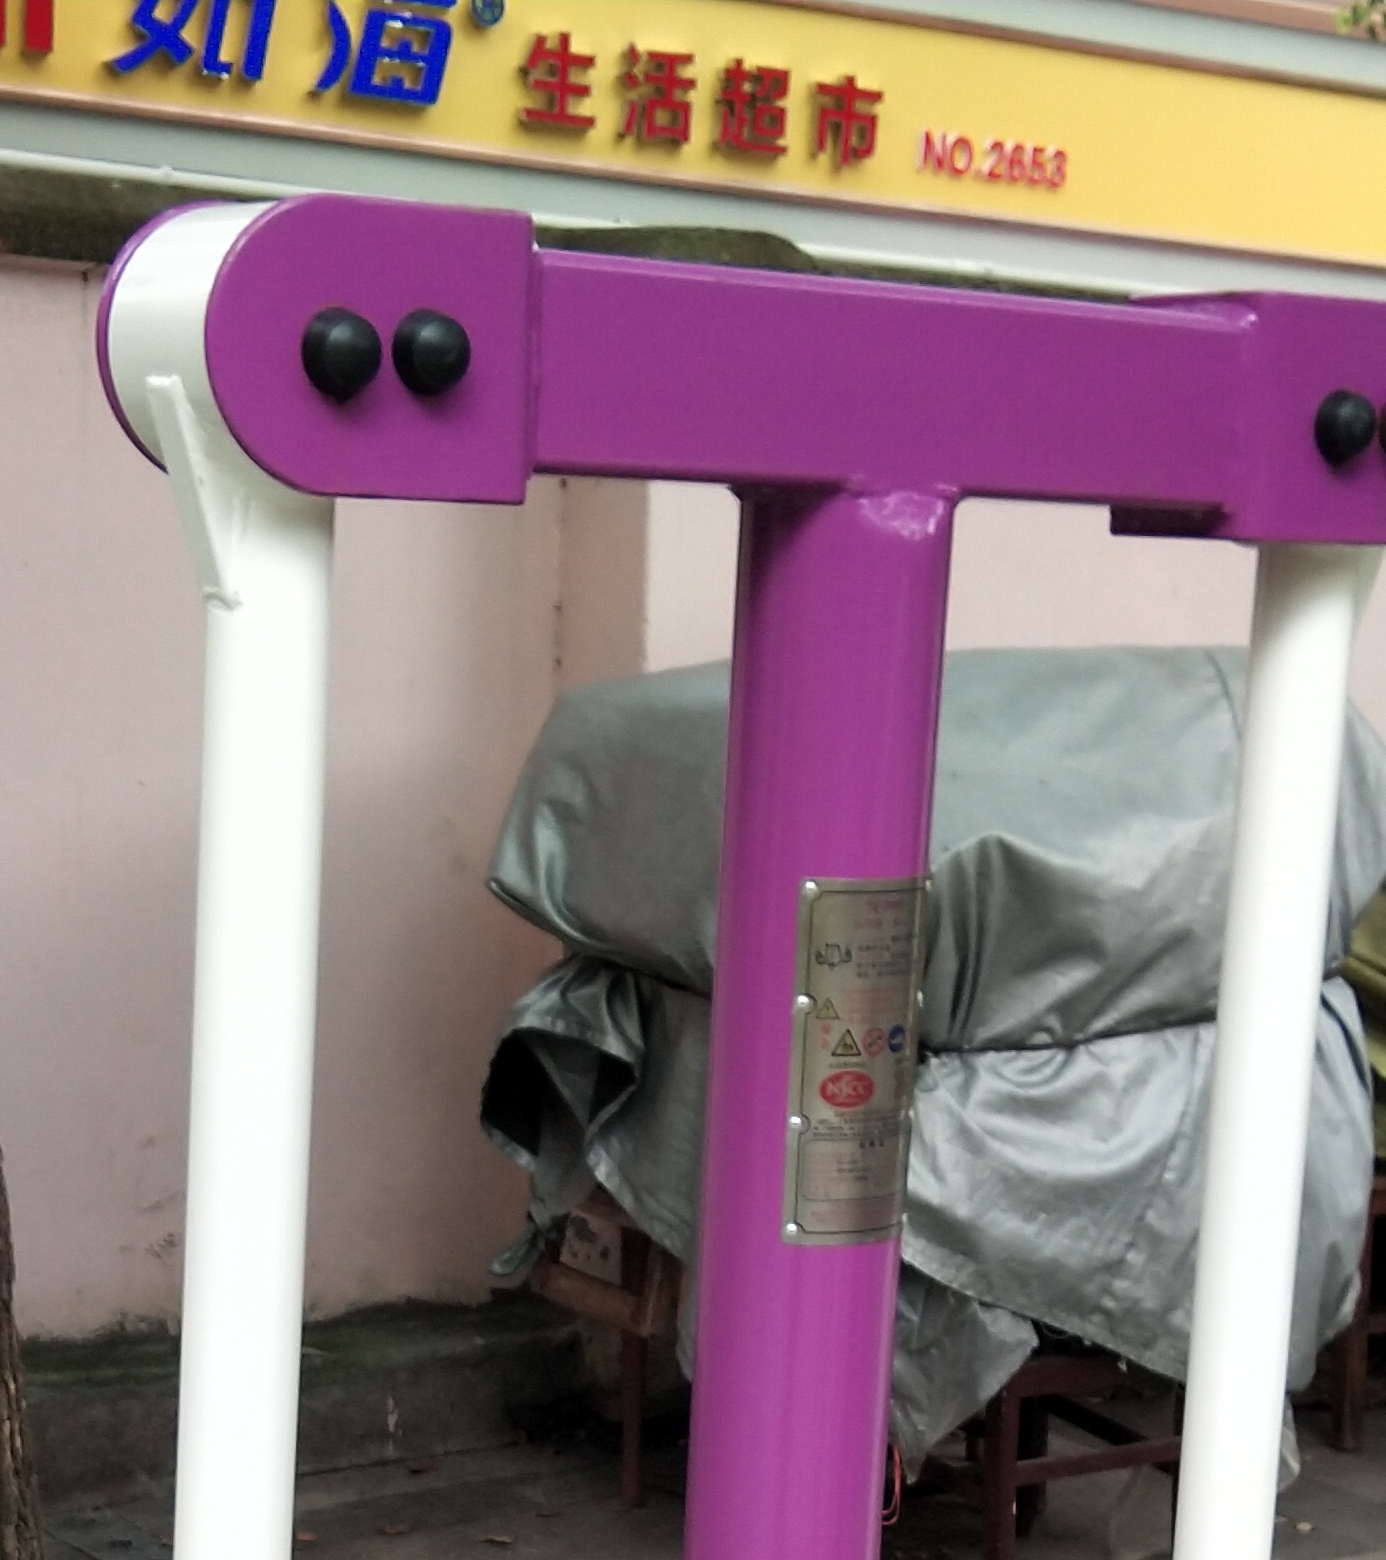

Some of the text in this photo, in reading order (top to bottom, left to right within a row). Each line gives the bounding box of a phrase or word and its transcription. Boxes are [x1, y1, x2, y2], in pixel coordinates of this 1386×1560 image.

[520, 30, 885, 169] 生活超市
[919, 130, 1068, 190] NO.2653
